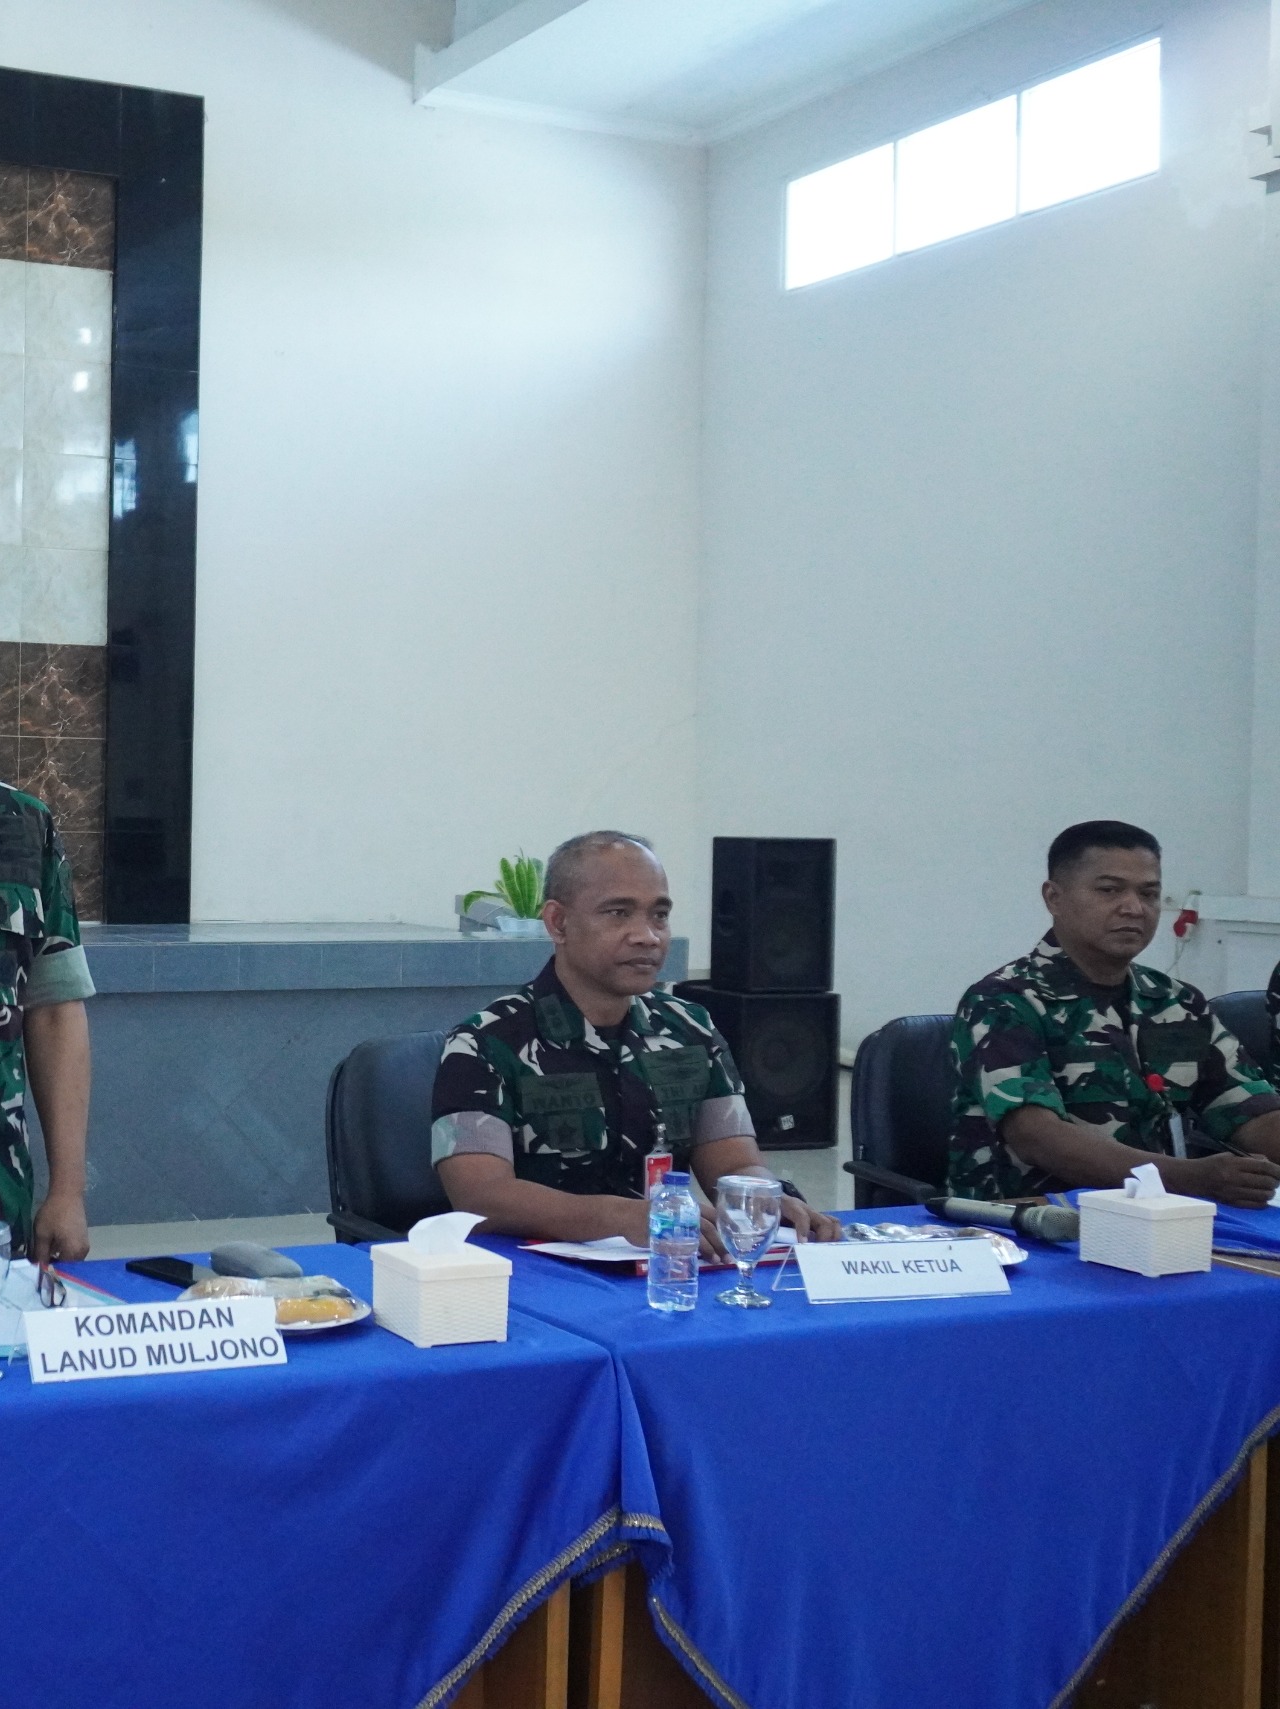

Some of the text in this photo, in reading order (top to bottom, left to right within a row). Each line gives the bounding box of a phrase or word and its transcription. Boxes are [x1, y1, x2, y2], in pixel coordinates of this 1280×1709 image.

[841, 1259, 963, 1274] WAKIL KETUA
[74, 1306, 234, 1338] KOMANDAN
[41, 1336, 279, 1374] LANUD MULJONO
